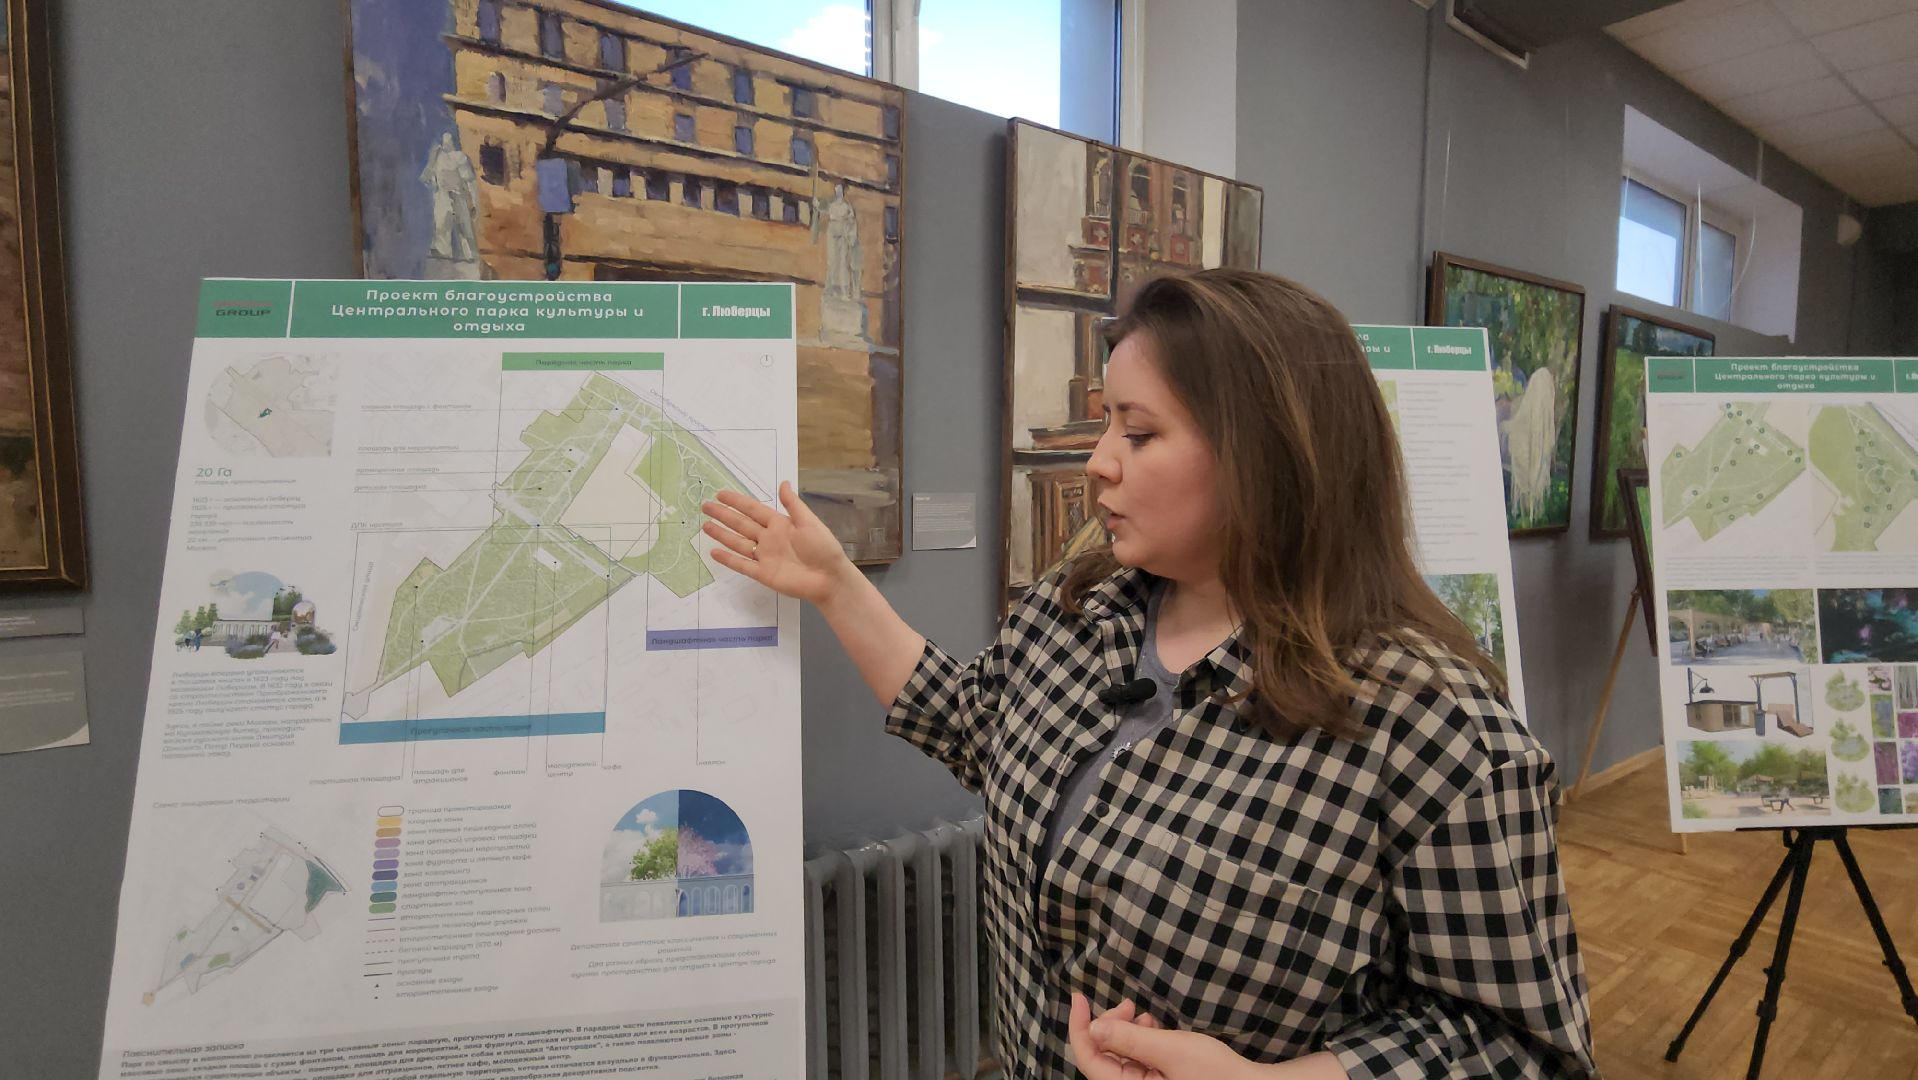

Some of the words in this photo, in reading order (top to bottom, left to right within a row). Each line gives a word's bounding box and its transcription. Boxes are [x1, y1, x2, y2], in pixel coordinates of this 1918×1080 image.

[366, 290, 438, 303] Проект
[444, 290, 613, 304] благоустройства
[215, 309, 271, 317] GROUP
[331, 305, 469, 318] Центрального
[475, 307, 530, 319] парка
[535, 307, 628, 319] культуры
[633, 307, 644, 317] и
[702, 307, 711, 317] г.
[712, 305, 771, 318] Люберцы
[453, 322, 526, 334] отдыха
[1730, 363, 1769, 372] Проект
[1771, 362, 1860, 373] благоустройства
[1714, 372, 1786, 382] Центрального
[194, 467, 213, 477] 20
[217, 467, 232, 477] Га
